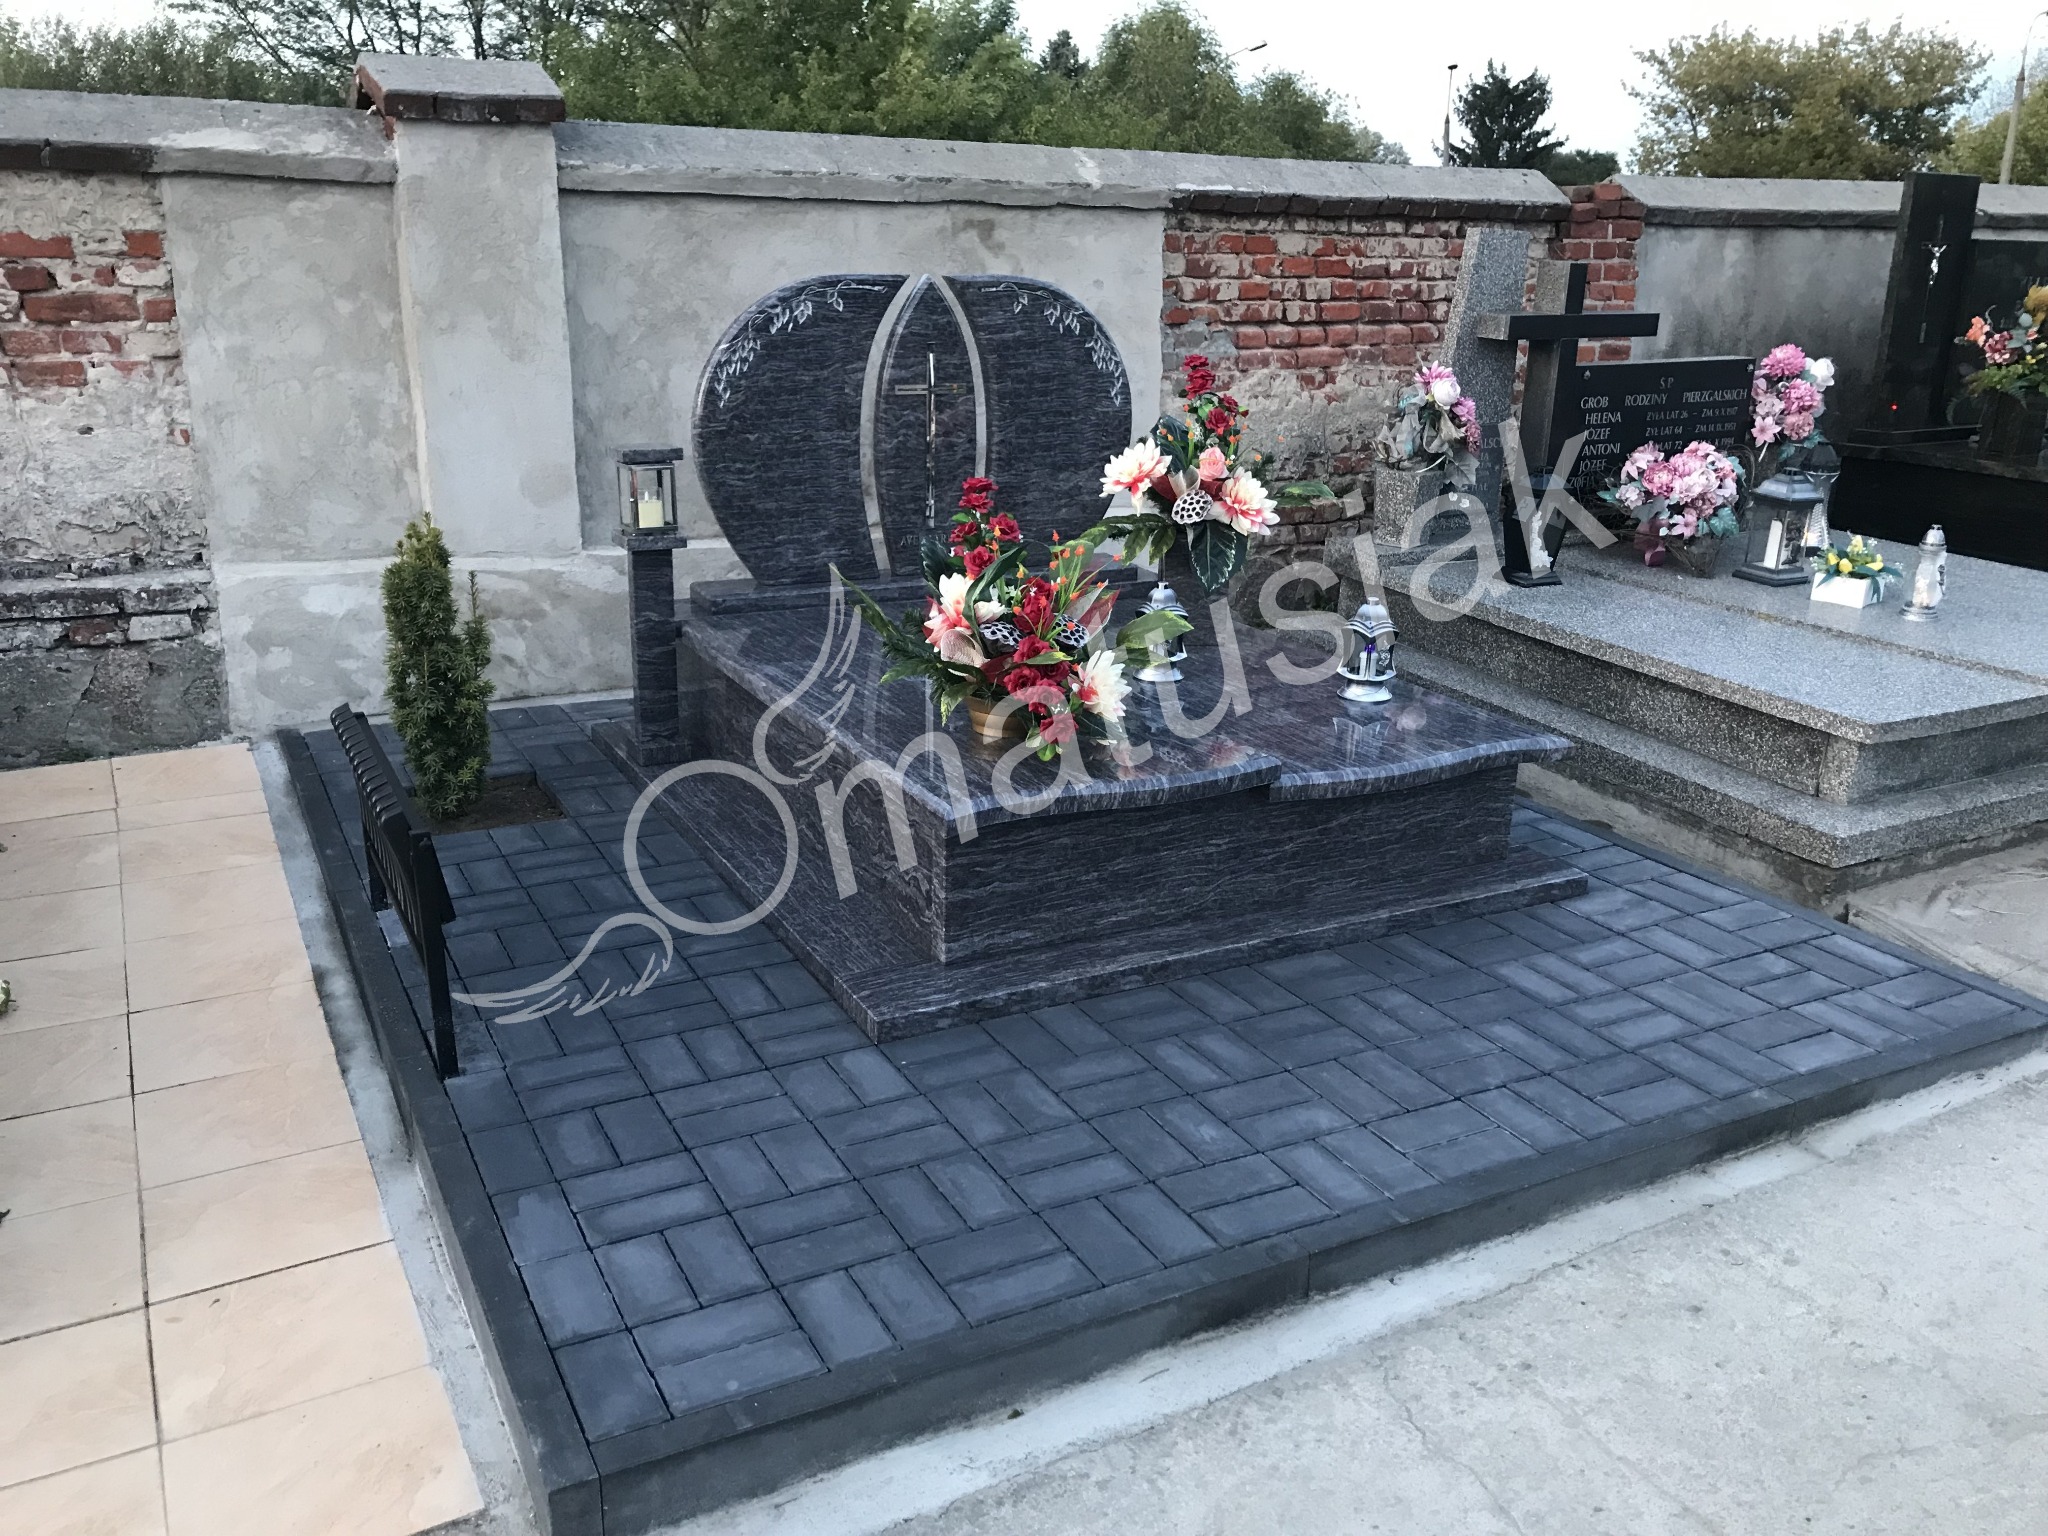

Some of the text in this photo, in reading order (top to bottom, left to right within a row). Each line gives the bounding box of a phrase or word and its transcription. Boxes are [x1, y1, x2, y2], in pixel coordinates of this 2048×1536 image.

[1625, 393, 1668, 407] RODZINY
[1585, 411, 1621, 425] HELENA
[1581, 443, 1621, 457] ANTONI
